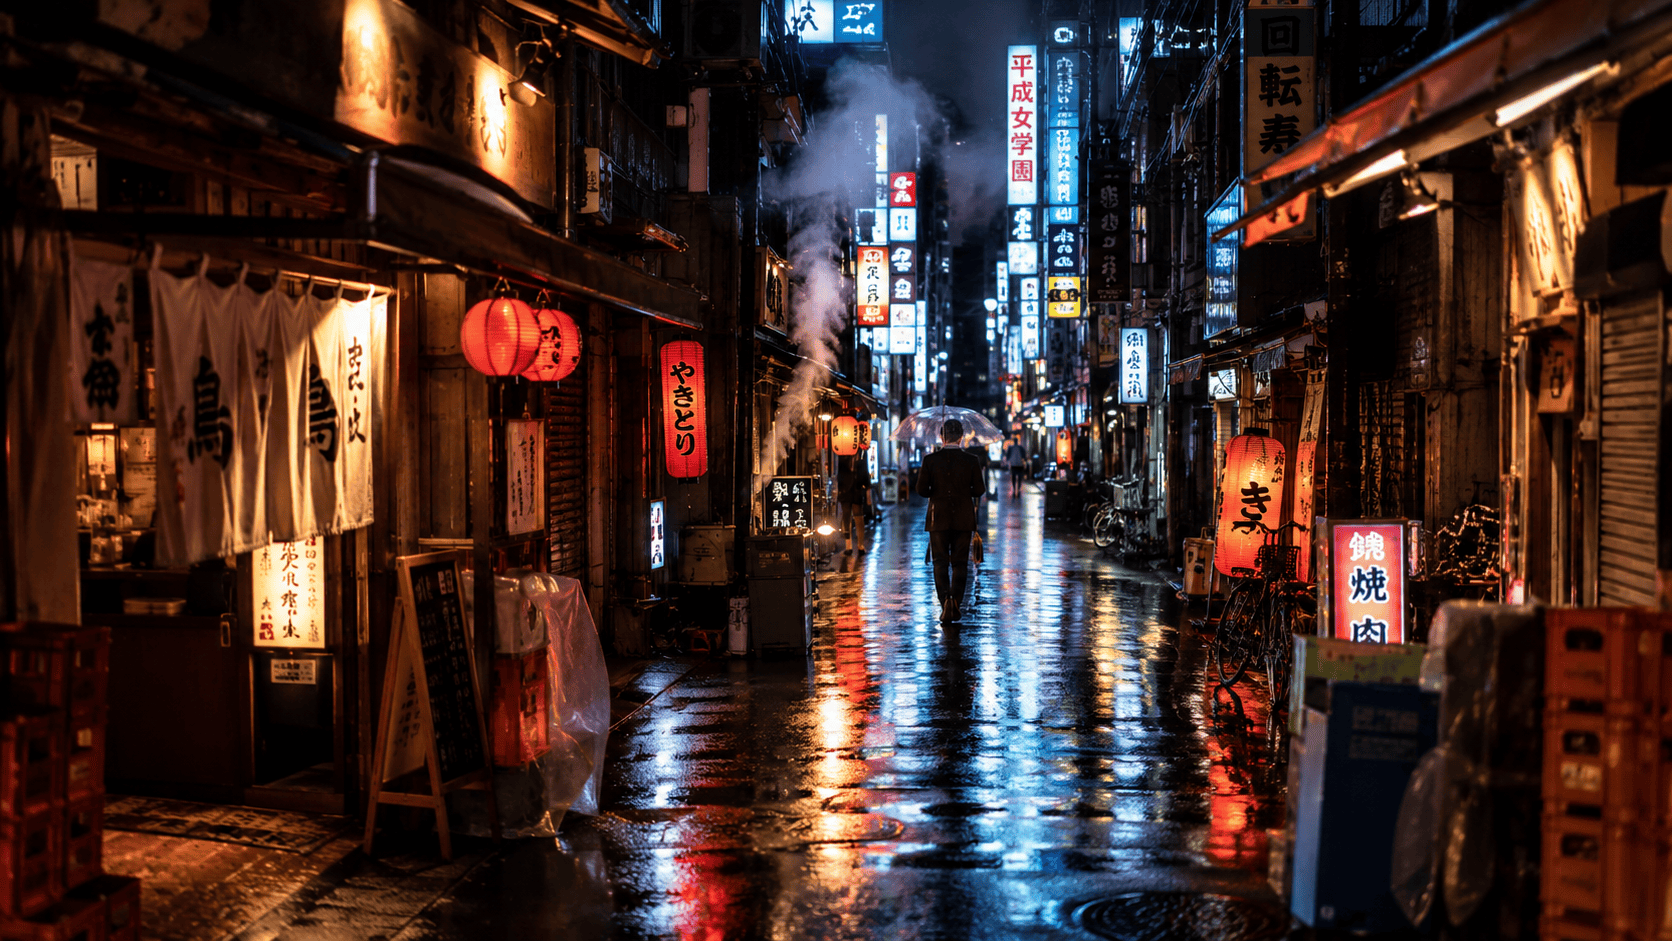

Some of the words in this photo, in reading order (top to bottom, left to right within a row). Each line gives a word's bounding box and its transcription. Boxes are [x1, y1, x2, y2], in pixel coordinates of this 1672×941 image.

[1258, 15, 1302, 198] 回転寿
[669, 361, 696, 457] やきとり
